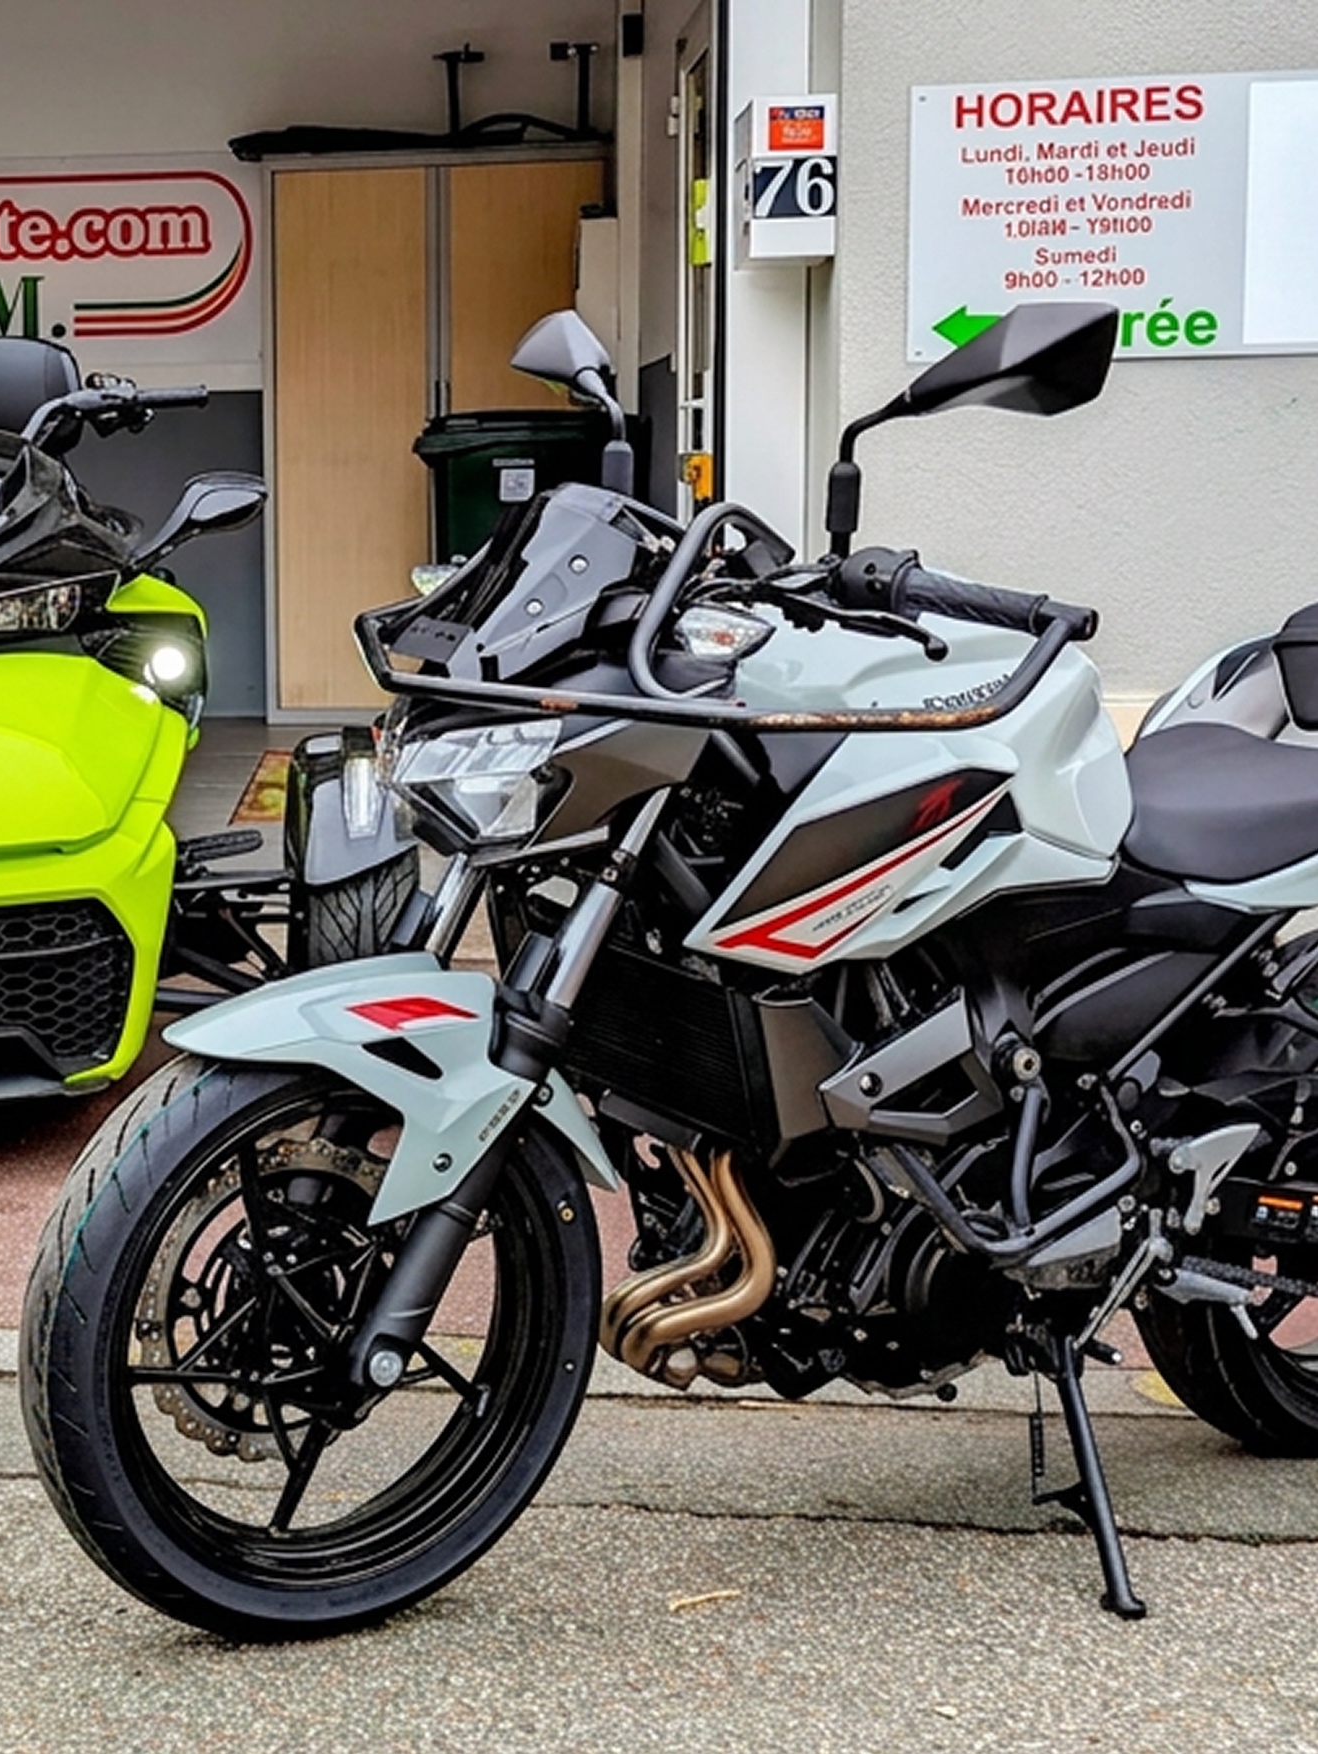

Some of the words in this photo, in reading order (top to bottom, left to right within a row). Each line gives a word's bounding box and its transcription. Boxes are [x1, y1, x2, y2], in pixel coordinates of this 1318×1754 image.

[954, 84, 1204, 129] HORAIRES
[1036, 141, 1099, 160] Mardi
[1106, 140, 1128, 158] et
[1134, 137, 1196, 157] Jeudi
[754, 158, 835, 217] 76
[961, 195, 1059, 216] Mercredi
[1004, 270, 1059, 290] 9h00
[1120, 297, 1219, 348] rée
